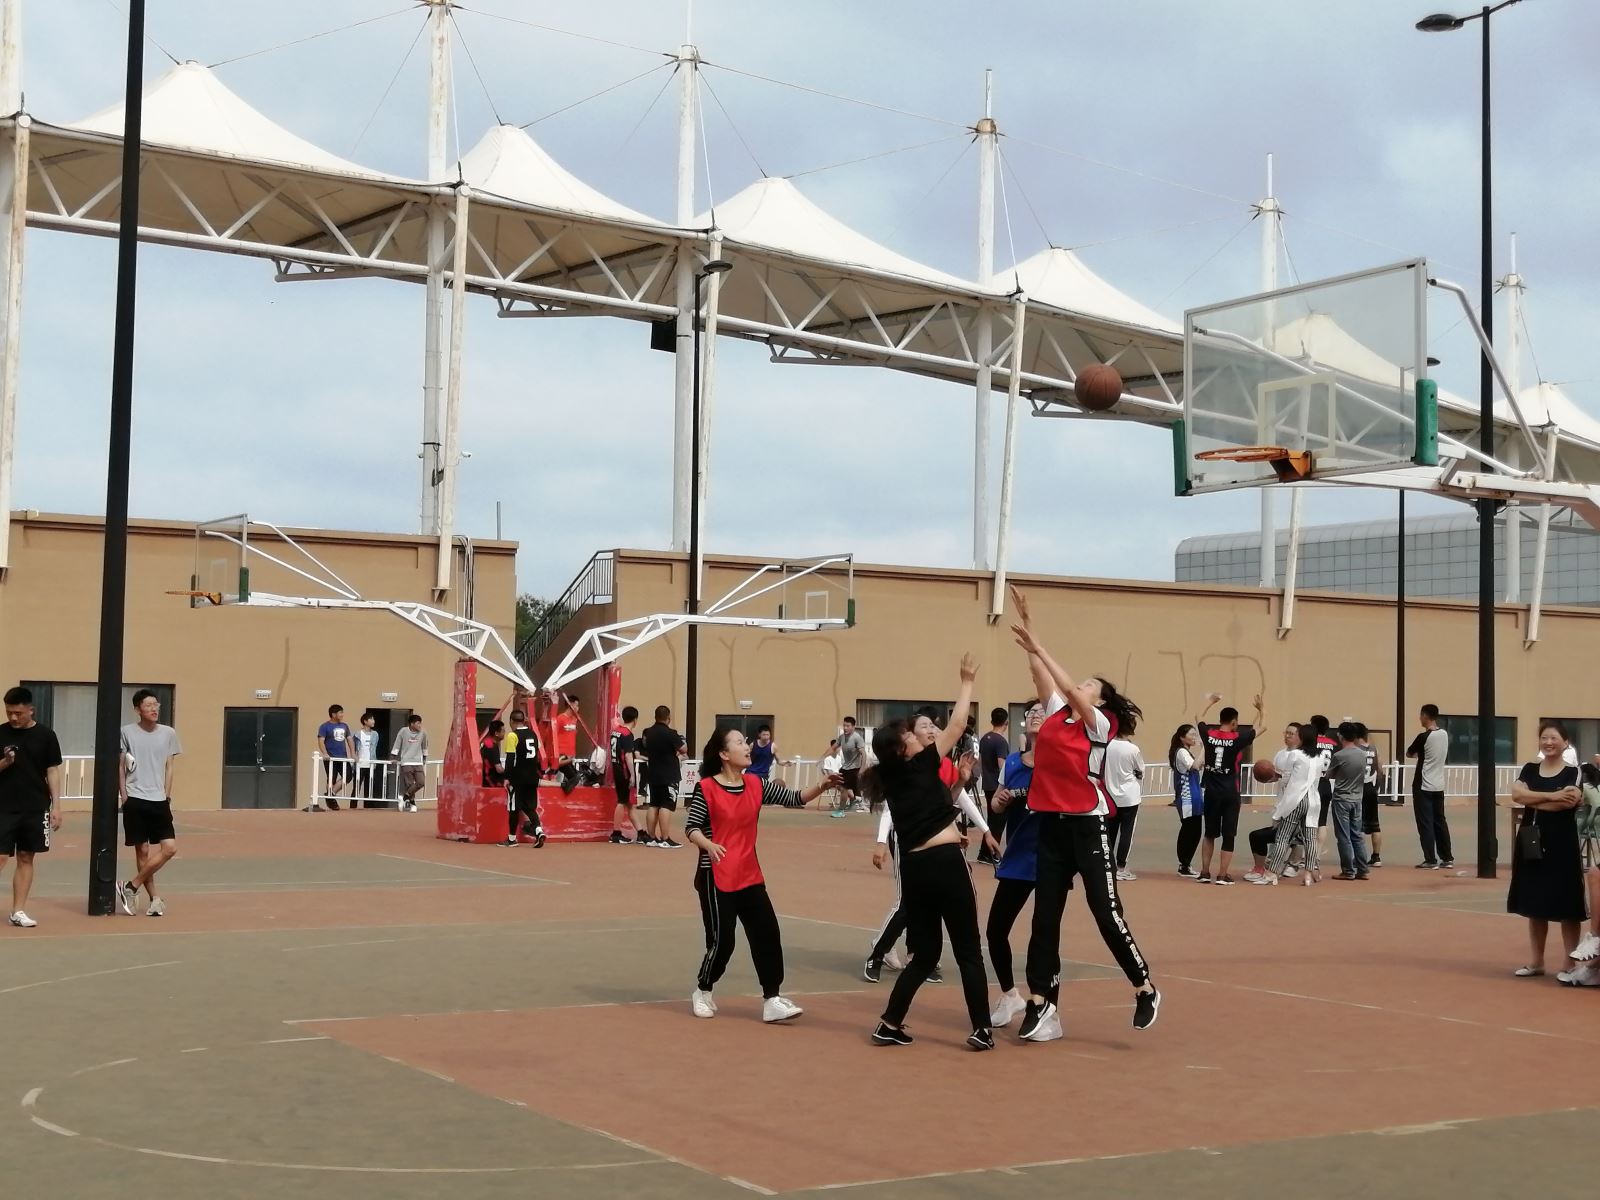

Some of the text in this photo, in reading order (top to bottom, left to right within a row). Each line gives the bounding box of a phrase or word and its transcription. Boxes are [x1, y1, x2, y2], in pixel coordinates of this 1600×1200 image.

[525, 739, 536, 759] 5
[1208, 736, 1233, 747] ZHANG
[1214, 747, 1224, 769] 1
[42, 810, 50, 848] adida
